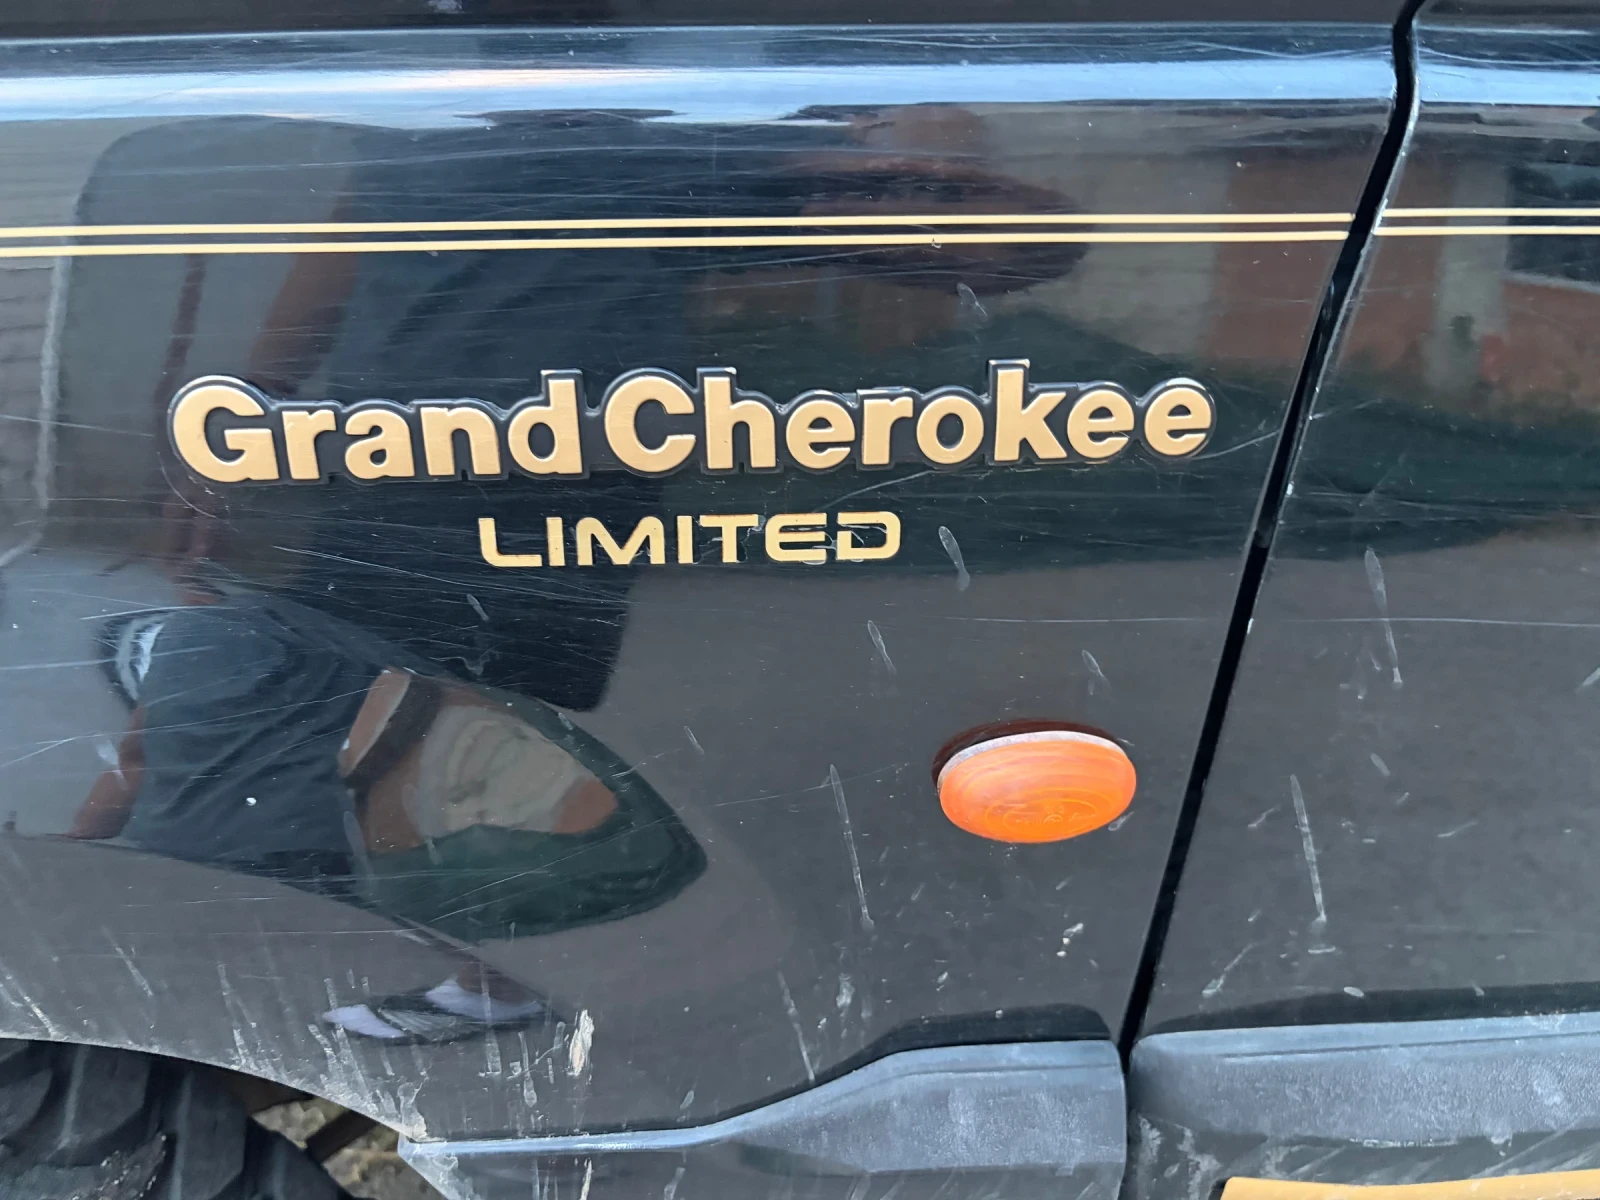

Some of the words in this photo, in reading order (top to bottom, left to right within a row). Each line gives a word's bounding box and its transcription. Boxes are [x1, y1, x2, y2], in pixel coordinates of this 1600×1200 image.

[171, 376, 584, 483] Grand
[603, 366, 1213, 474] Cherokee
[477, 510, 902, 568] LIMITED
